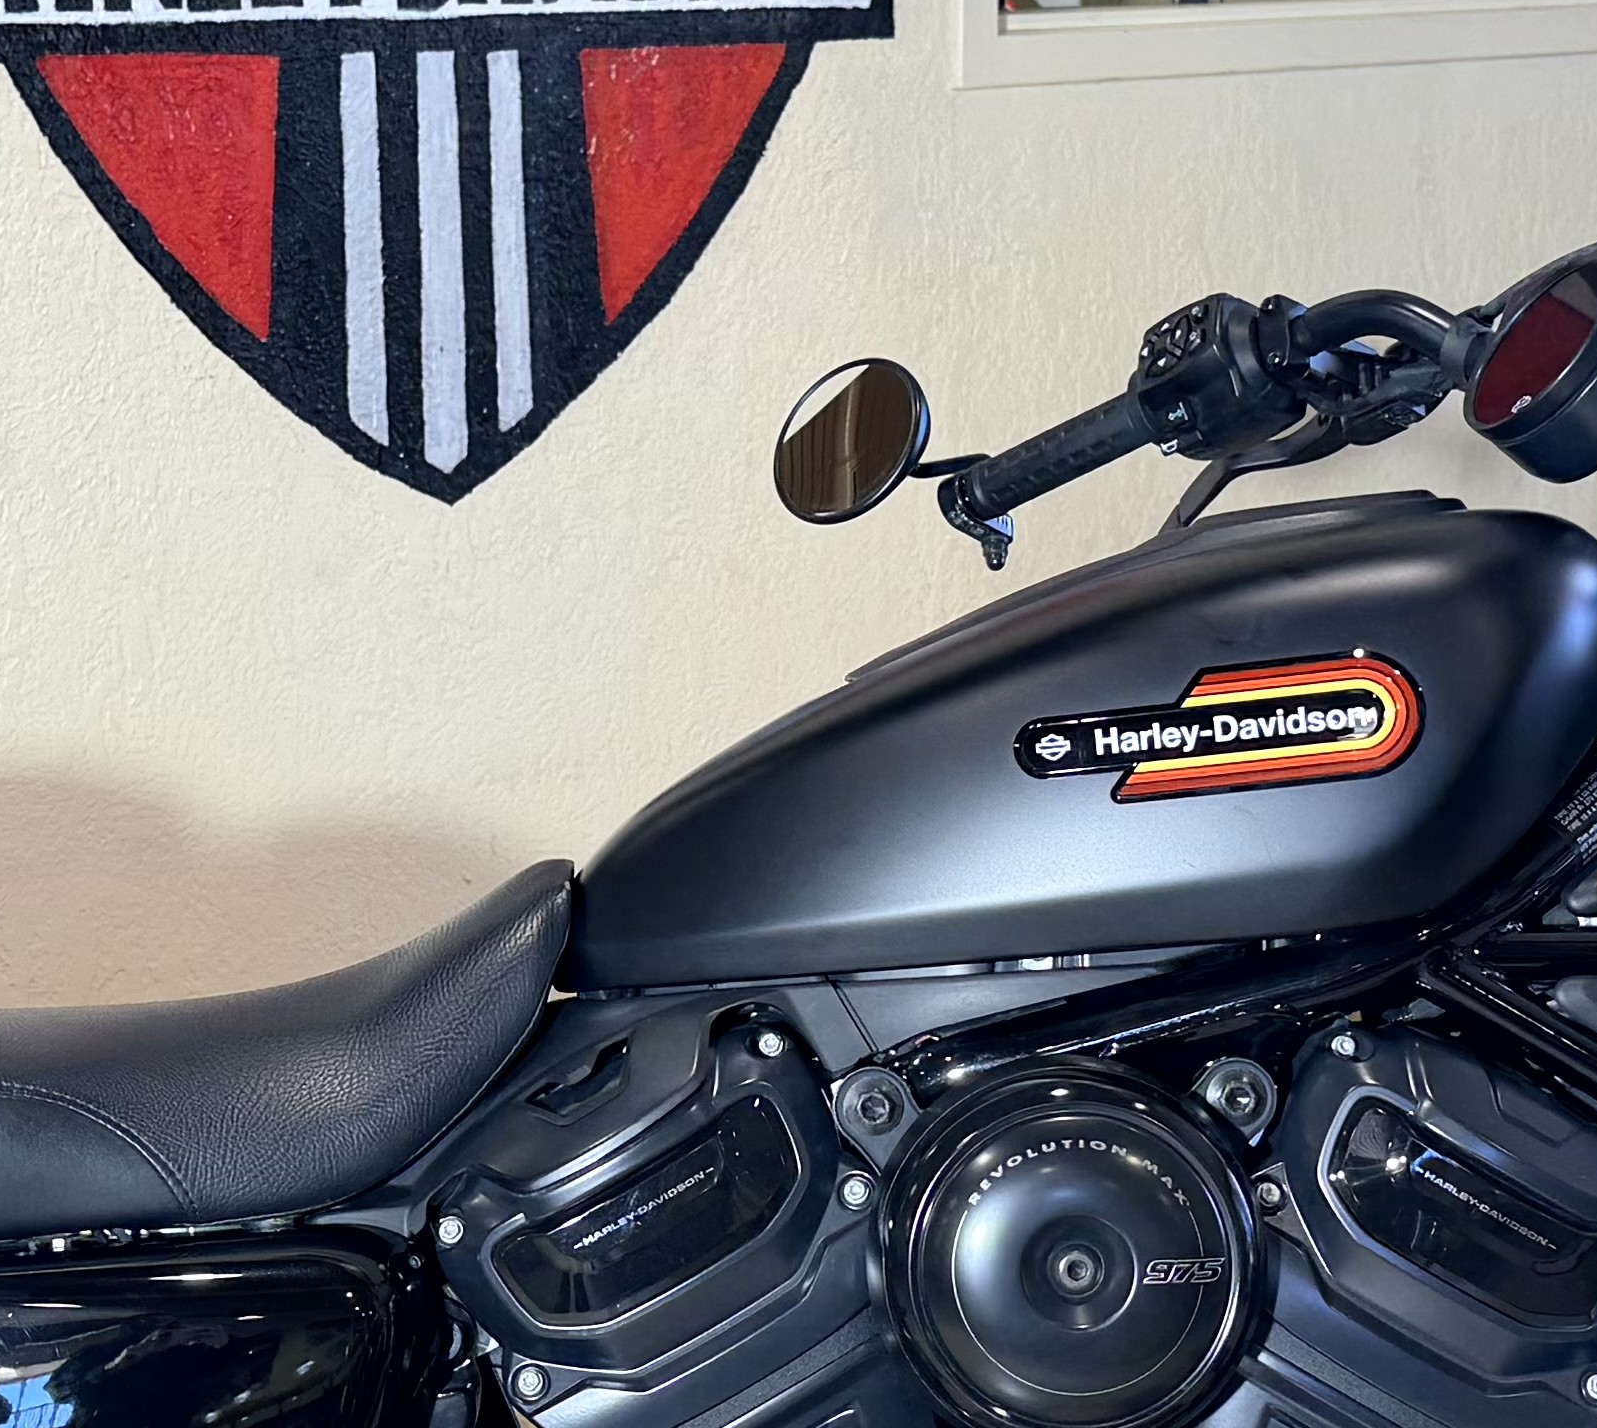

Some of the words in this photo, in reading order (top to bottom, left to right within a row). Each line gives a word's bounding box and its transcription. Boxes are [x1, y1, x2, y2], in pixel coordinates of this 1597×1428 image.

[1093, 705, 1370, 756] Harley-Davidson
[967, 1138, 1128, 1207] REVOLUTION
[1140, 1158, 1191, 1208] MAX
[1142, 1257, 1227, 1286] 975
